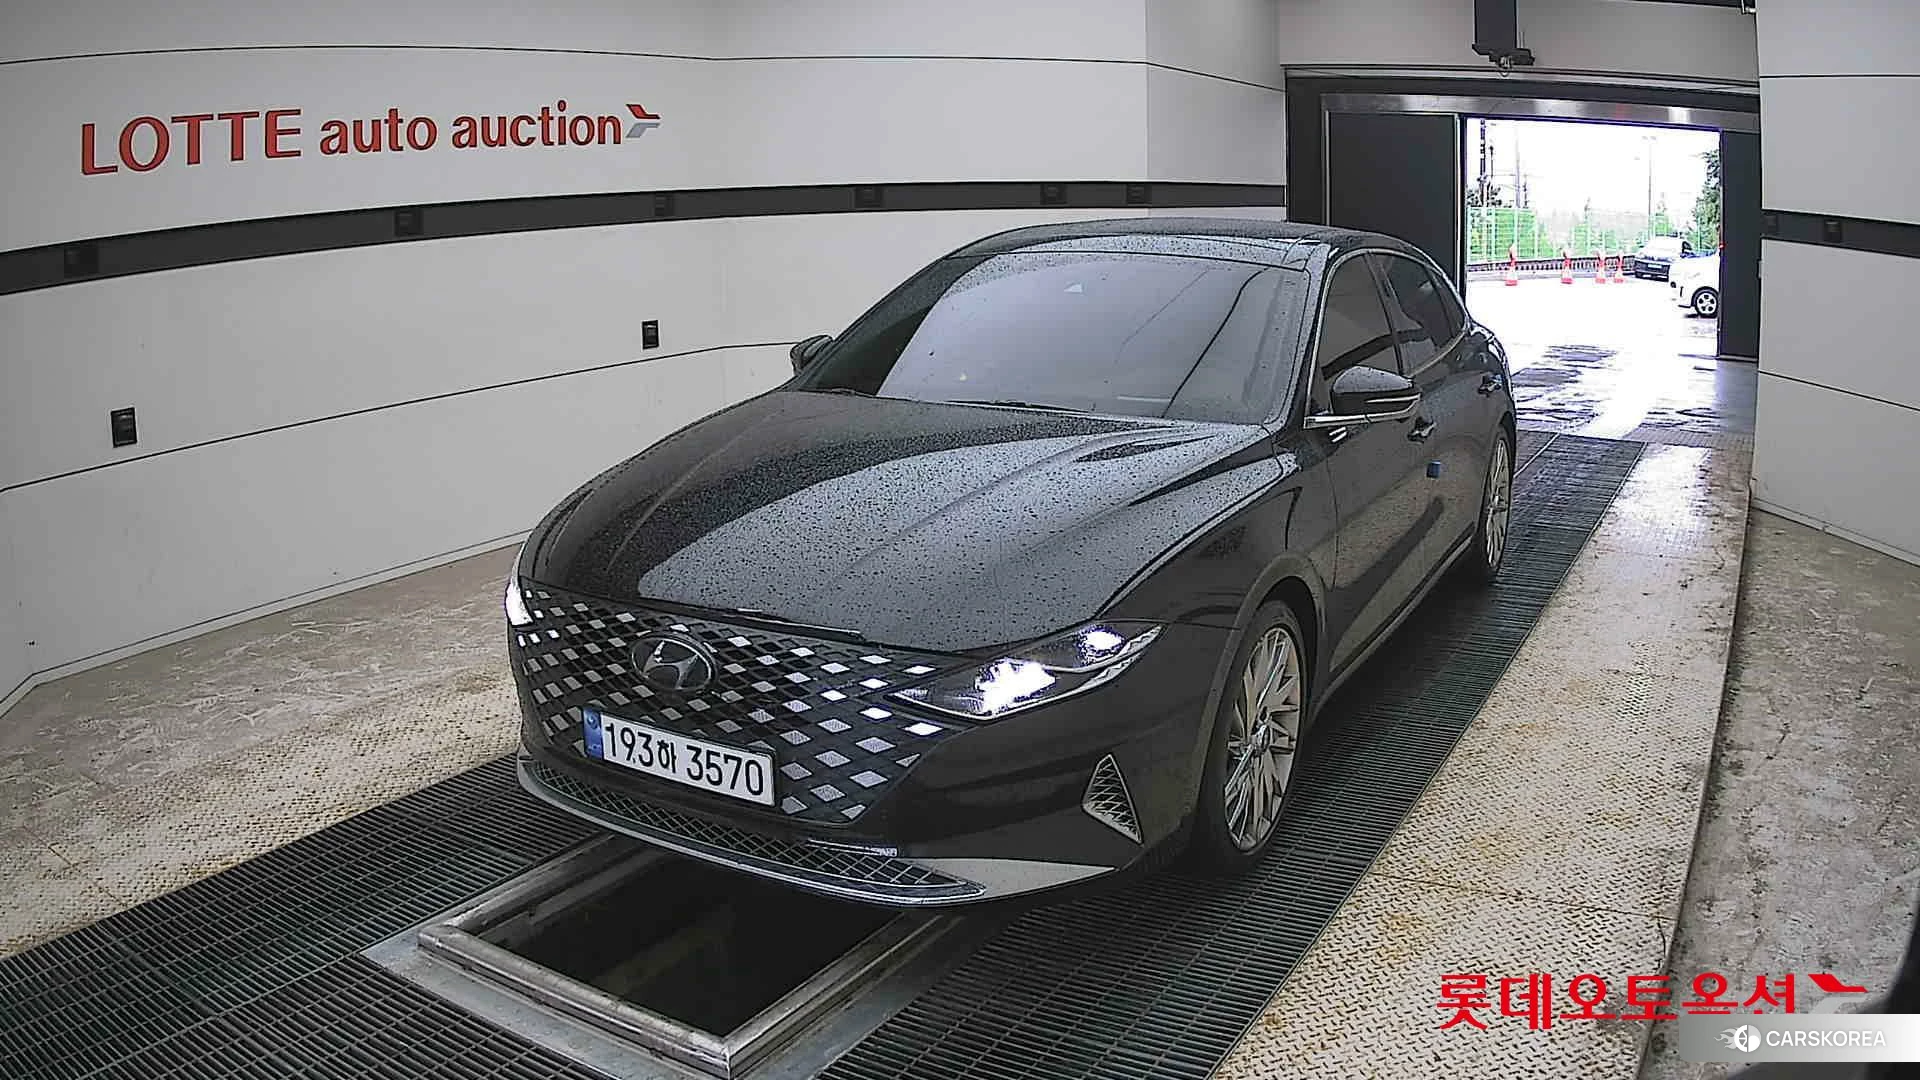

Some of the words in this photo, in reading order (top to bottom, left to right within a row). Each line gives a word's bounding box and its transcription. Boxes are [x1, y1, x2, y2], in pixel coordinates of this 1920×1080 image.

[81, 108, 302, 175] LOTTE
[319, 107, 438, 155] auto
[451, 99, 623, 149] auction
[605, 722, 677, 774] 193하
[686, 744, 764, 796] 3570
